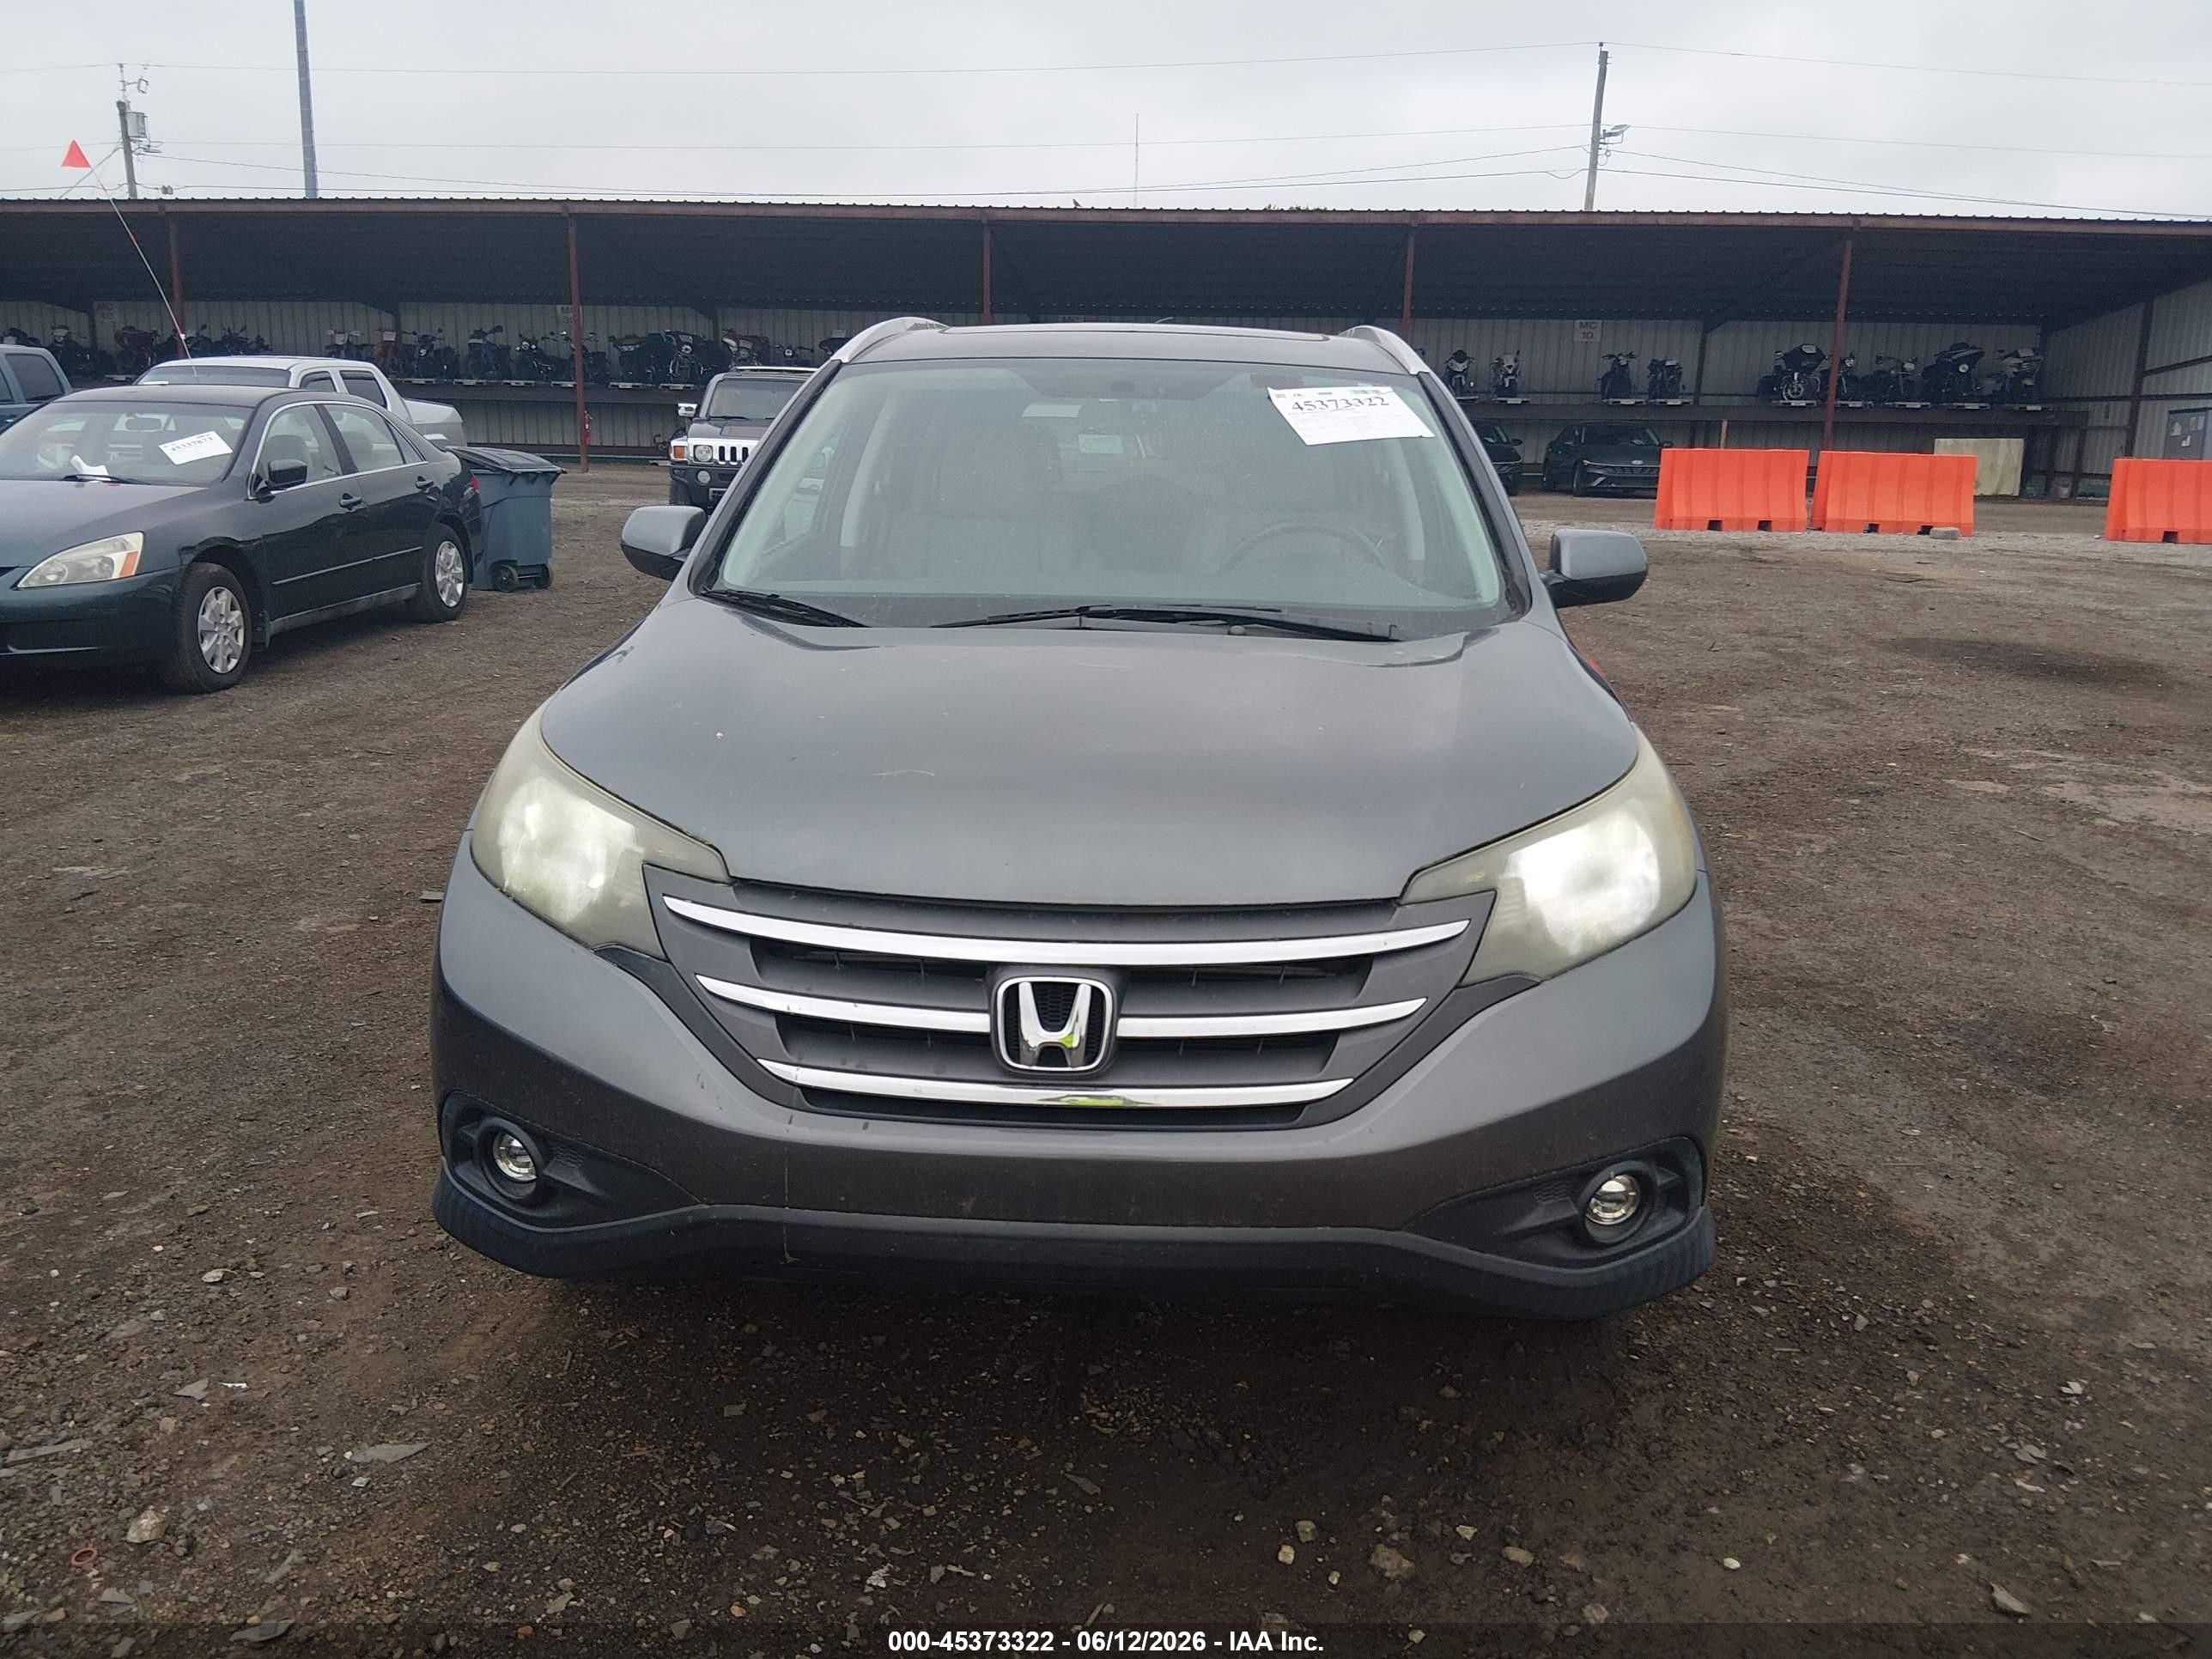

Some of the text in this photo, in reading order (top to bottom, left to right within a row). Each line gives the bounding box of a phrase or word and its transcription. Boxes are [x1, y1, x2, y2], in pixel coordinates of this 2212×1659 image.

[1579, 321, 1598, 330] MC
[1582, 331, 1594, 340] 10
[1291, 396, 1390, 411] 45373322
